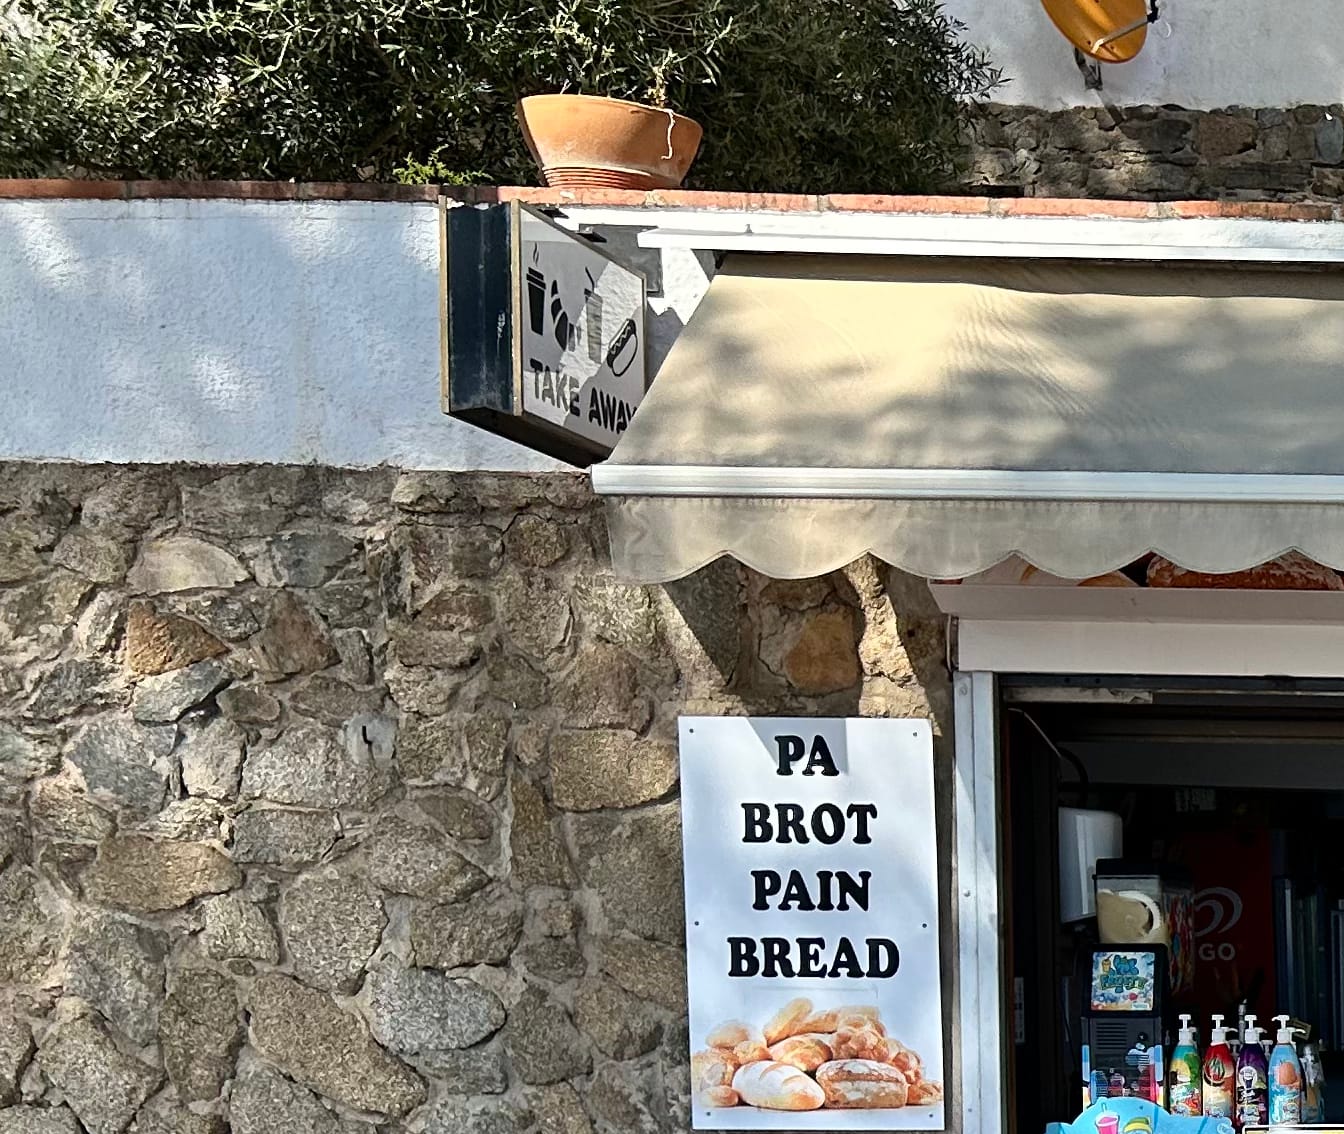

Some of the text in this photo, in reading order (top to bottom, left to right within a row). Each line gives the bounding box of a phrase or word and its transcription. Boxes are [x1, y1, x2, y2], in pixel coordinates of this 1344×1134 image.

[530, 358, 580, 417] TAKE
[774, 735, 839, 776] PA
[741, 803, 877, 844] BROT
[751, 870, 872, 911] PAIN
[727, 937, 900, 978] BREAD
